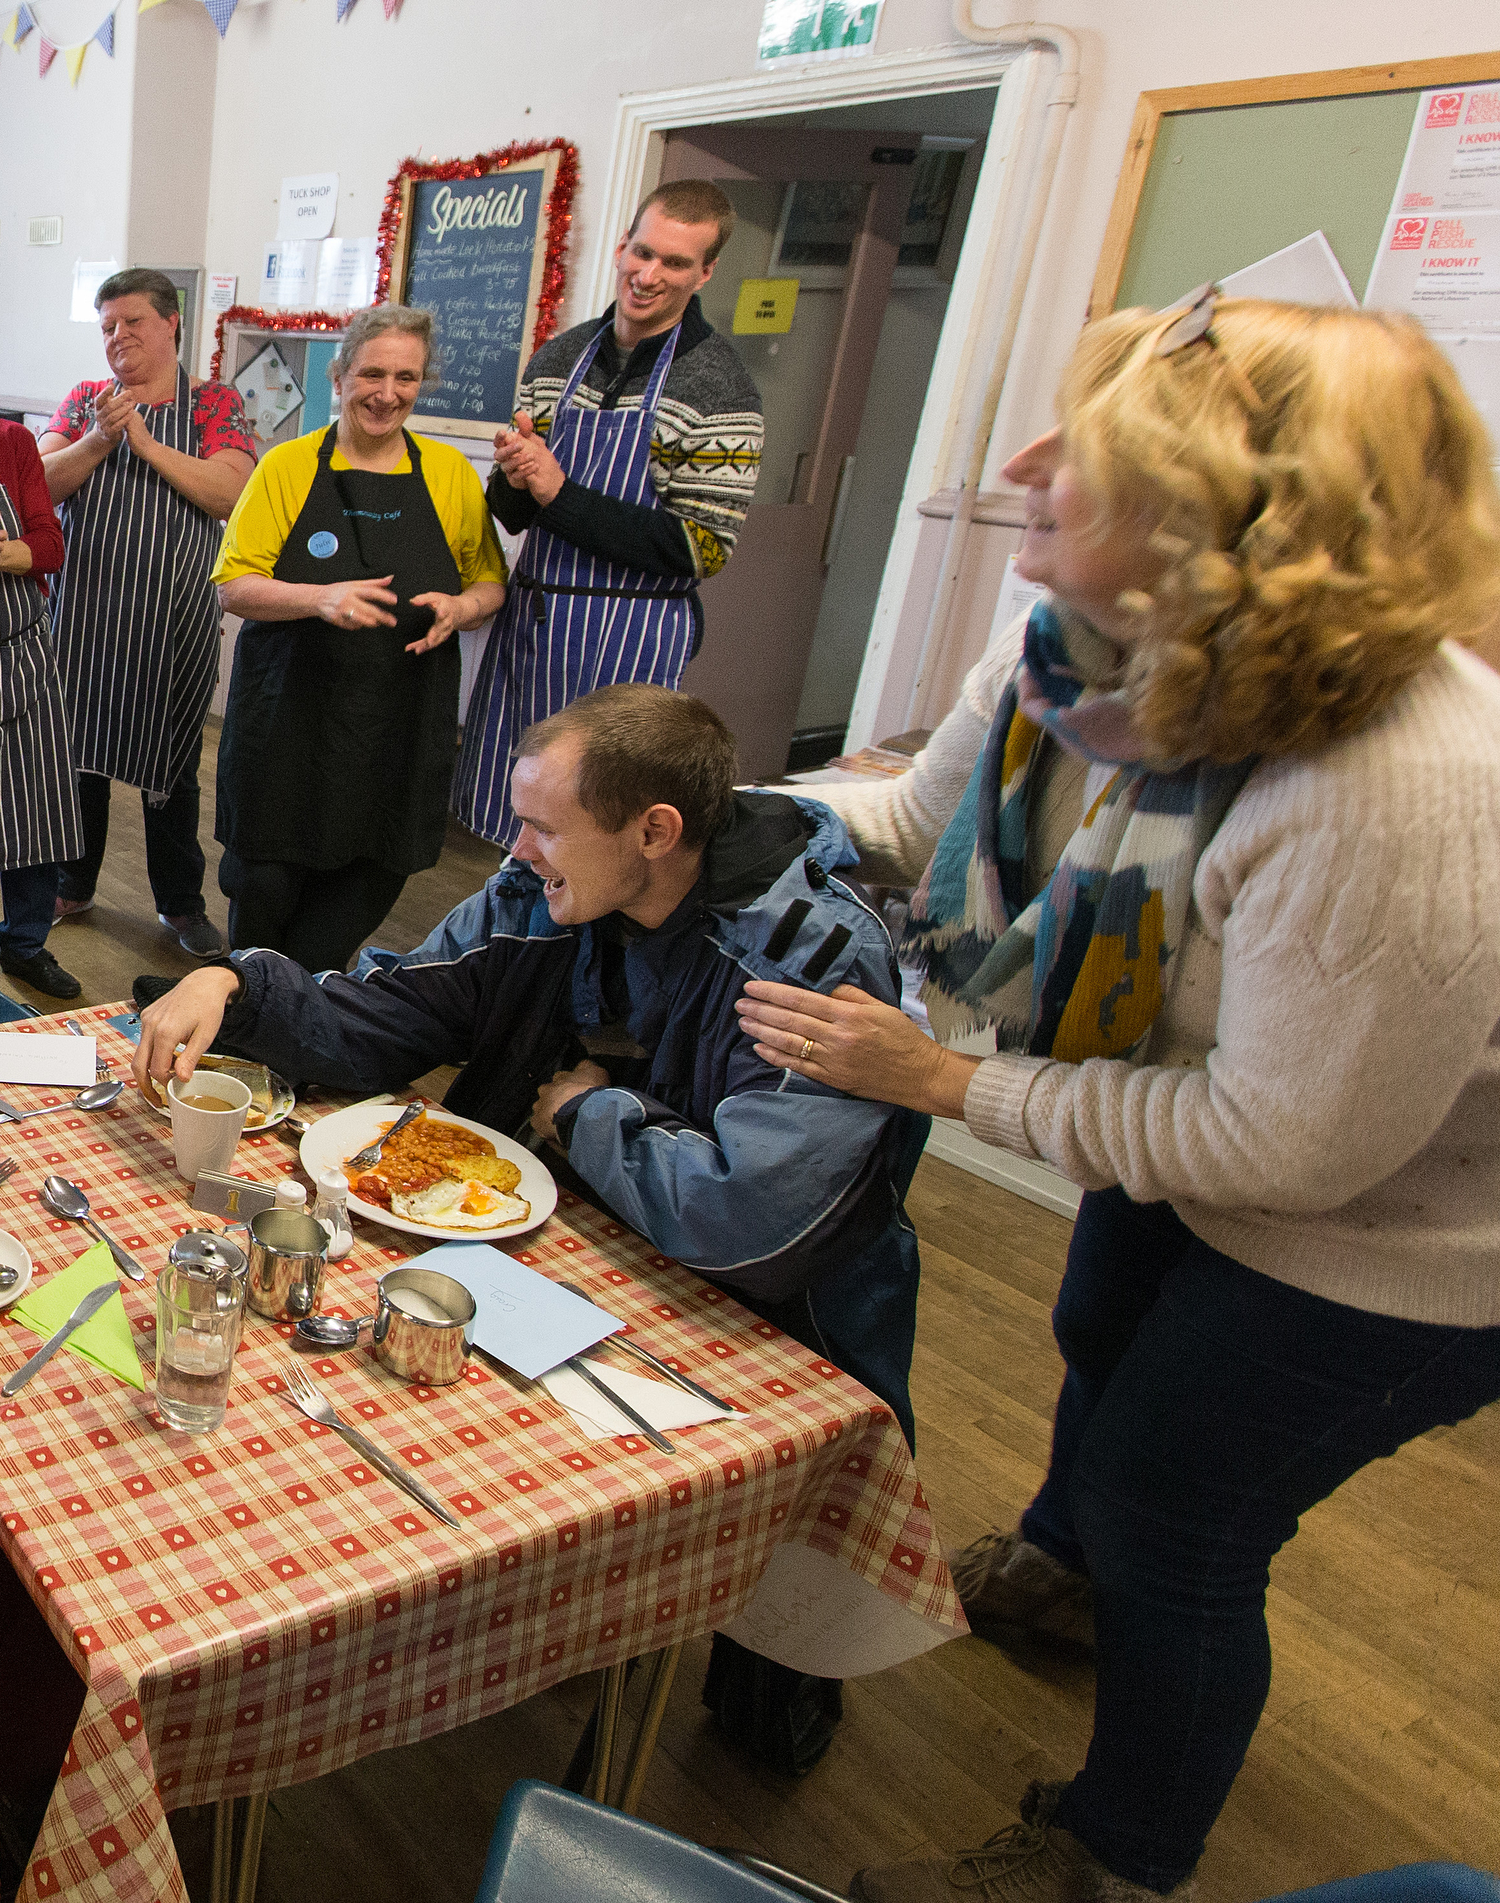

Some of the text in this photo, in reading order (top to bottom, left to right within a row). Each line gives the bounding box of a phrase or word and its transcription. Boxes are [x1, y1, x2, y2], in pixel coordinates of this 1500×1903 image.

[290, 185, 332, 200] TUCK SHOP
[297, 205, 319, 217] OPEN
[427, 184, 528, 243] Specials
[1434, 219, 1462, 230] CALL
[1428, 238, 1477, 249] RESCUE
[1428, 257, 1467, 268] KNOW
[1467, 257, 1482, 267] IT
[225, 1188, 239, 1213] 1
